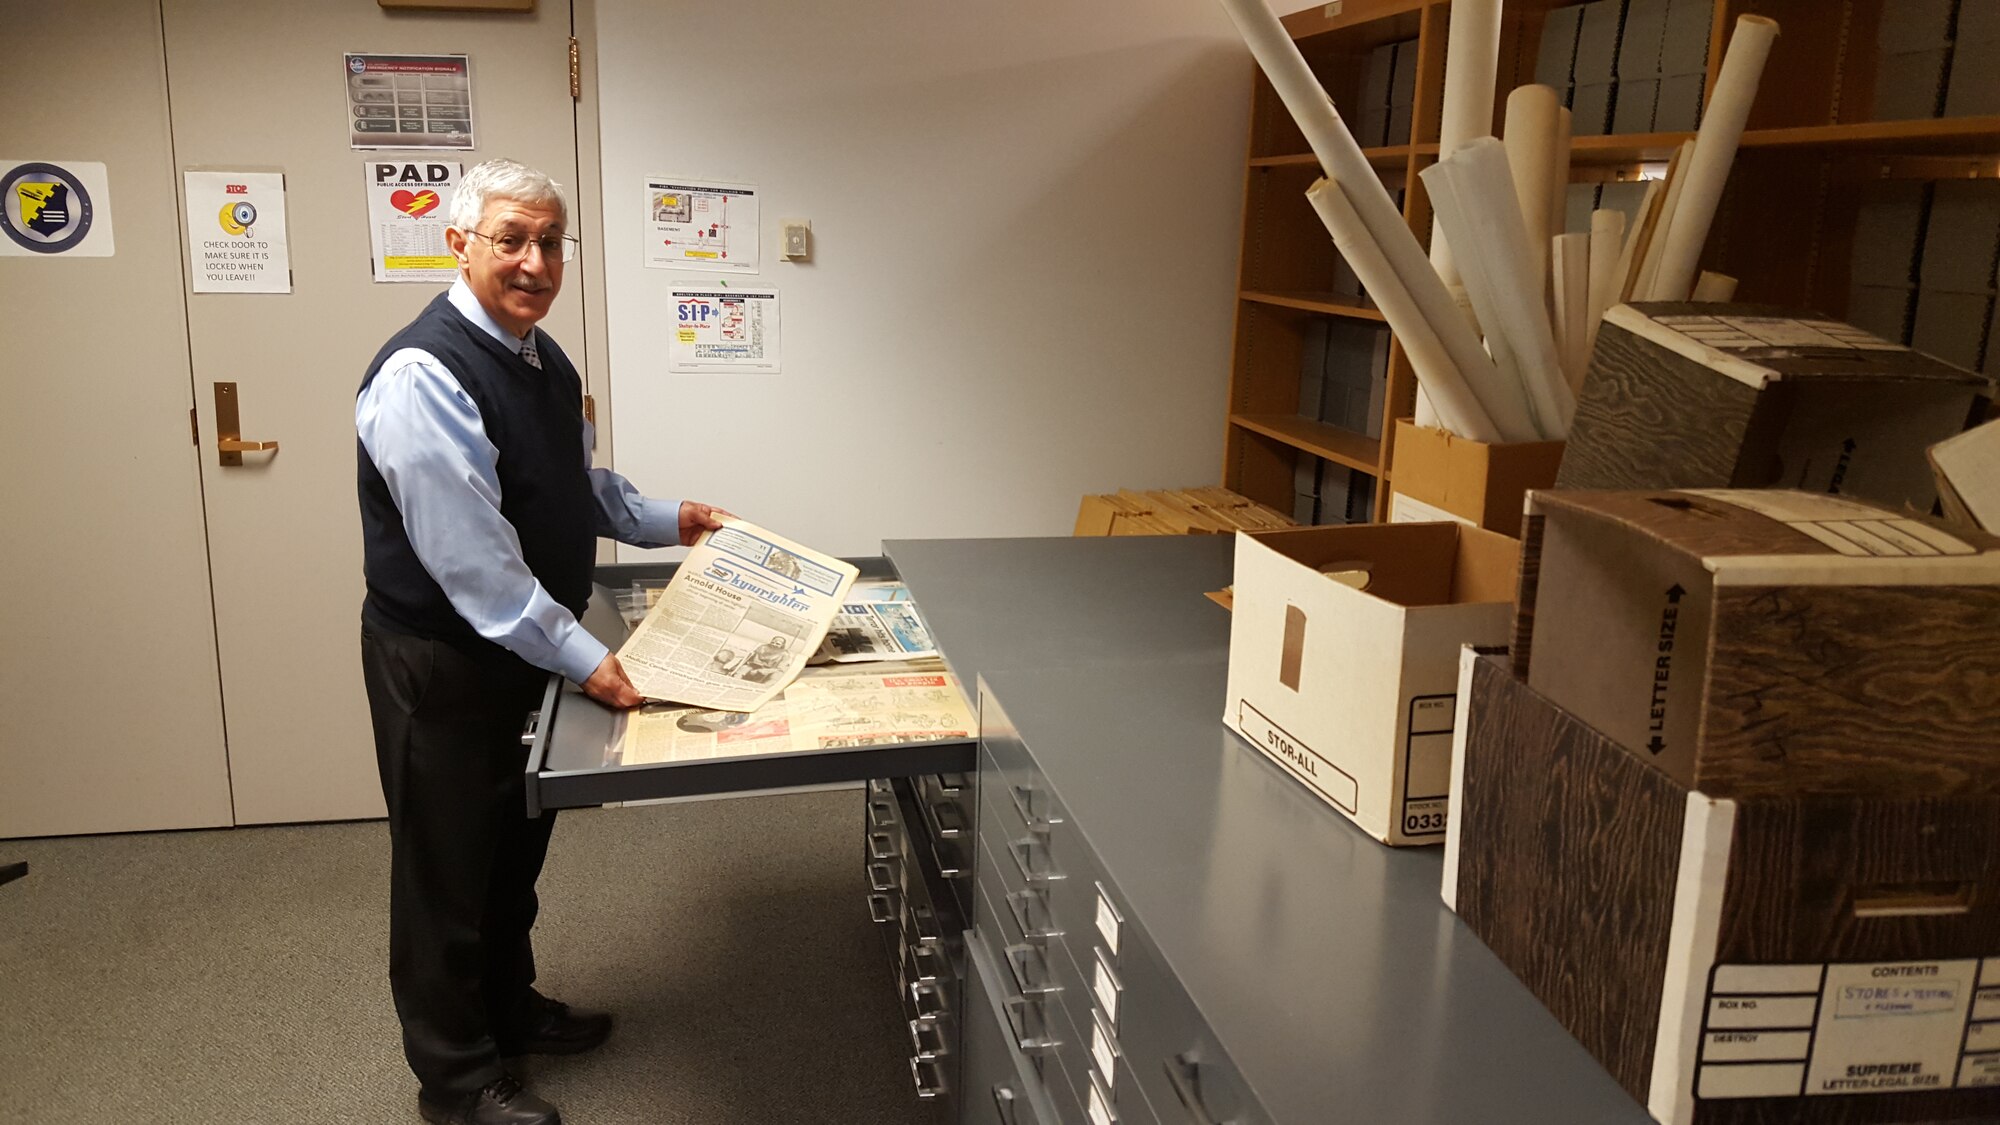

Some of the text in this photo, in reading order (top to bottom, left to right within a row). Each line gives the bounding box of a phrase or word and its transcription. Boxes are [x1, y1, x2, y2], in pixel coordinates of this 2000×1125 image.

[376, 164, 449, 182] PAD
[226, 184, 248, 194] STOP
[684, 575, 714, 589] Arnold
[715, 586, 742, 601] House
[1650, 608, 1678, 731] LETTER SIZE
[1267, 730, 1318, 777] STOR-ALL
[1871, 965, 1939, 978] CONTENTS
[1718, 1001, 1738, 1009] BOX
[1713, 1034, 1758, 1043] DESTROY
[1846, 1062, 1922, 1077] SUPREME
[1822, 1074, 1940, 1090] LETTER-LEGAL SIZE
